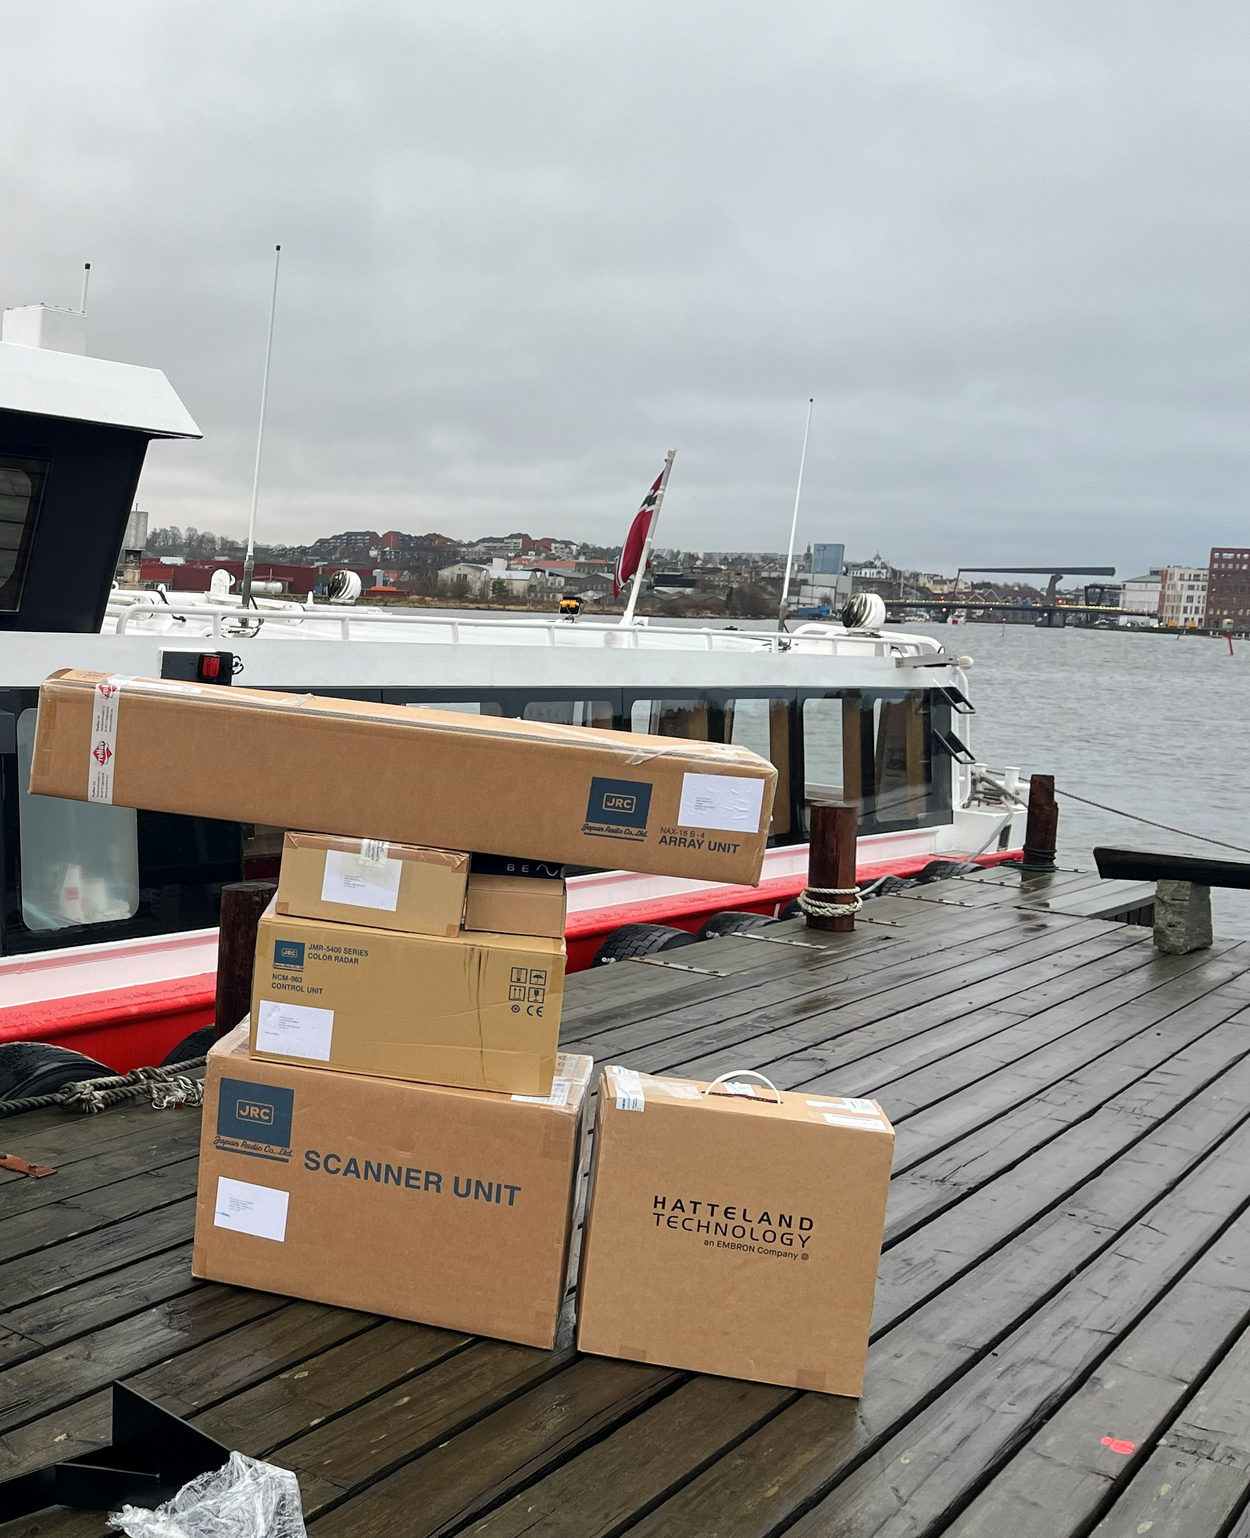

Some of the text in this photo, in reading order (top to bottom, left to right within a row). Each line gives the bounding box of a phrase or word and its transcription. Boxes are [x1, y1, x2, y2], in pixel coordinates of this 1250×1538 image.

[606, 797, 632, 809] JRC
[658, 834, 740, 854] ARRAY UNIT
[282, 949, 296, 957] JRC
[308, 943, 369, 957] JMR-5400 SERIES
[307, 952, 359, 965] COLOR RADAR
[271, 982, 324, 995] CONTROL UNIT
[239, 1105, 270, 1120] JRC
[213, 1135, 239, 1147] Japan
[240, 1140, 263, 1152] Radio
[303, 1149, 522, 1206] SCANNER UNIT
[653, 1195, 814, 1231] HATTELAND
[652, 1212, 811, 1249] TECHNOLOGY
[703, 1239, 799, 1261] an EMBRON Company
